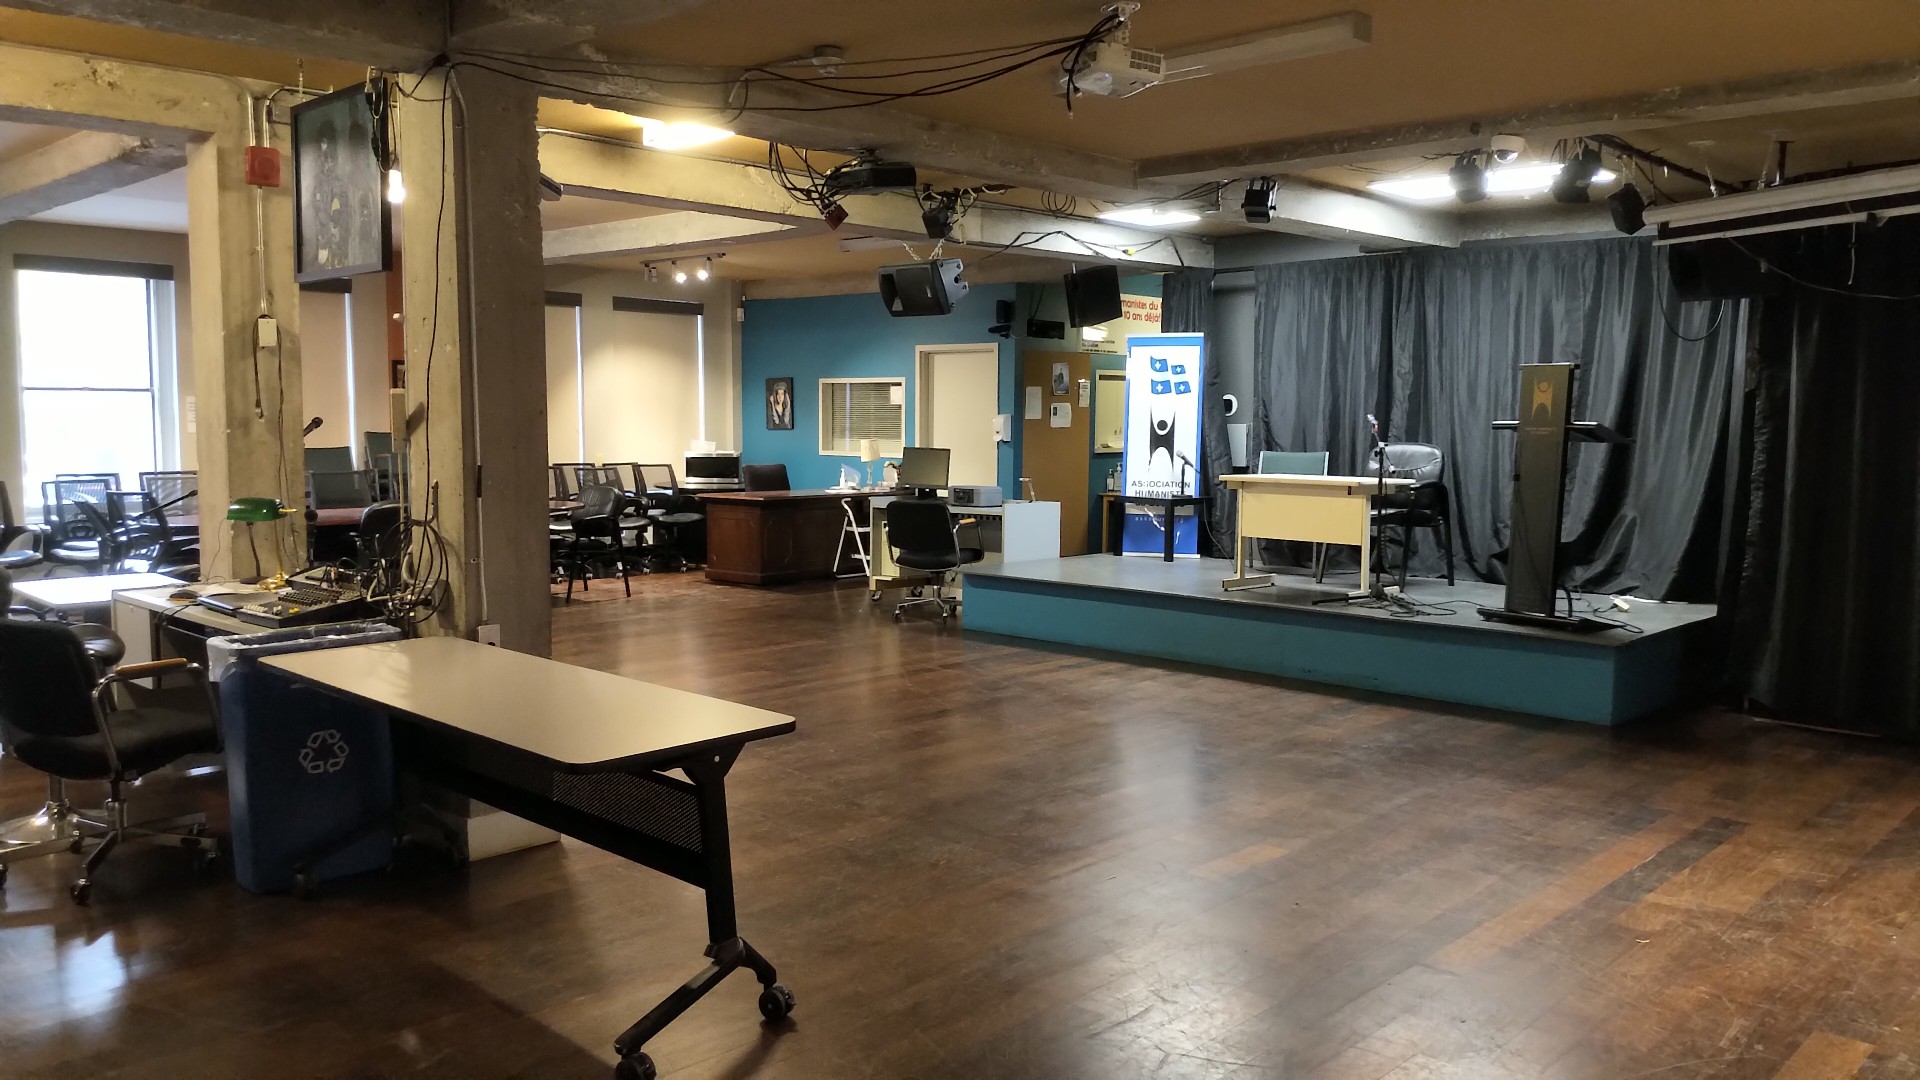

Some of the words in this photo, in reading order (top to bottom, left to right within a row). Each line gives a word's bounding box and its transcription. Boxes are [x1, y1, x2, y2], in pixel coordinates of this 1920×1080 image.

[1149, 301, 1158, 310] du
[1124, 310, 1130, 320] 10
[1134, 490, 1186, 498] HUMANIST
